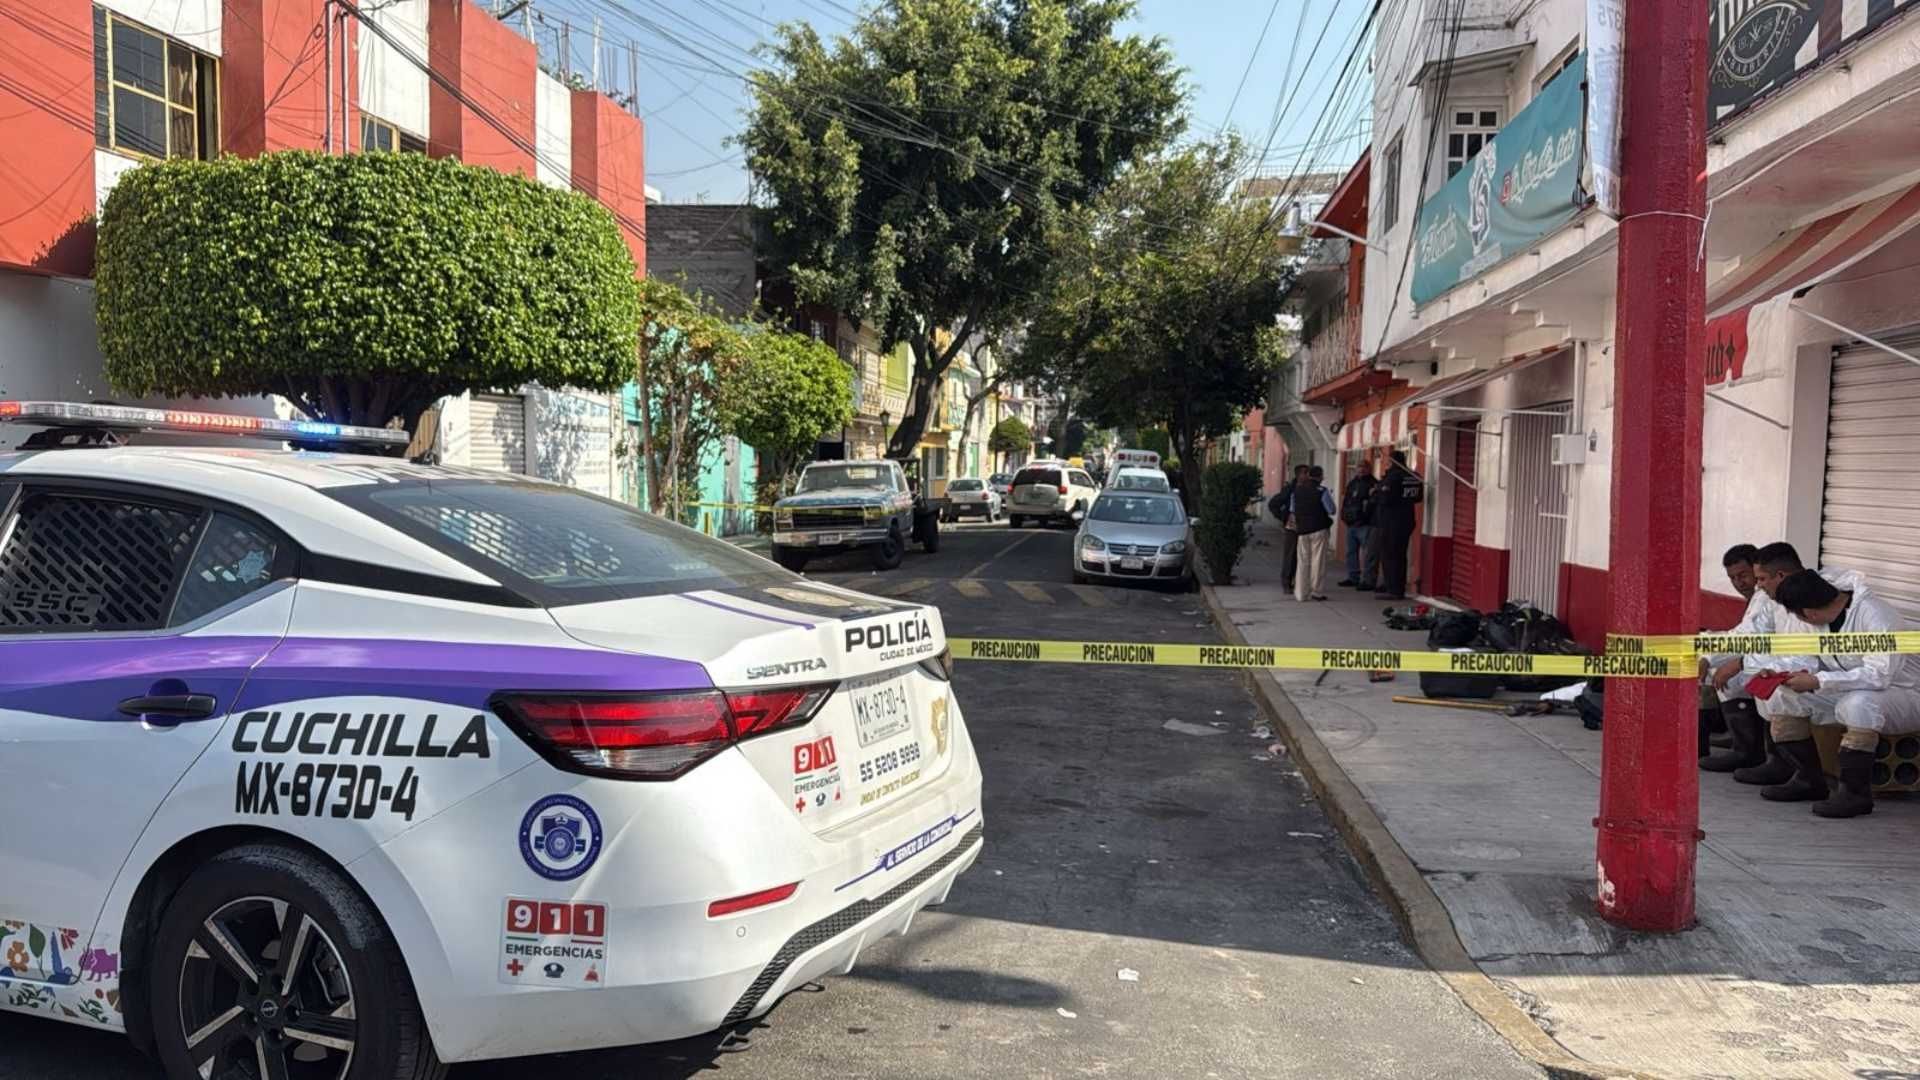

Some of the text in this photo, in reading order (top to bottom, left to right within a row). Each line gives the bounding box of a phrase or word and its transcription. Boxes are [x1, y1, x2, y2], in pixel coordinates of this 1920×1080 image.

[13, 592, 89, 612] SSC
[845, 611, 932, 653] POLICÍA
[1694, 636, 1771, 654] PRECAUCION
[1819, 634, 1897, 652] PRECAUCION
[747, 657, 827, 679] SENTRA
[971, 640, 1668, 675] PRECAUCION PRECAUCION PRECAUCION PRECAUCION PRECAUCION PRECAUCION
[232, 711, 491, 758] CUCHILLA
[798, 741, 834, 769] 911
[859, 760, 874, 783] 55
[875, 750, 898, 776] 5208
[514, 904, 595, 932] 911
[506, 943, 603, 960] EMERGENCIAS
